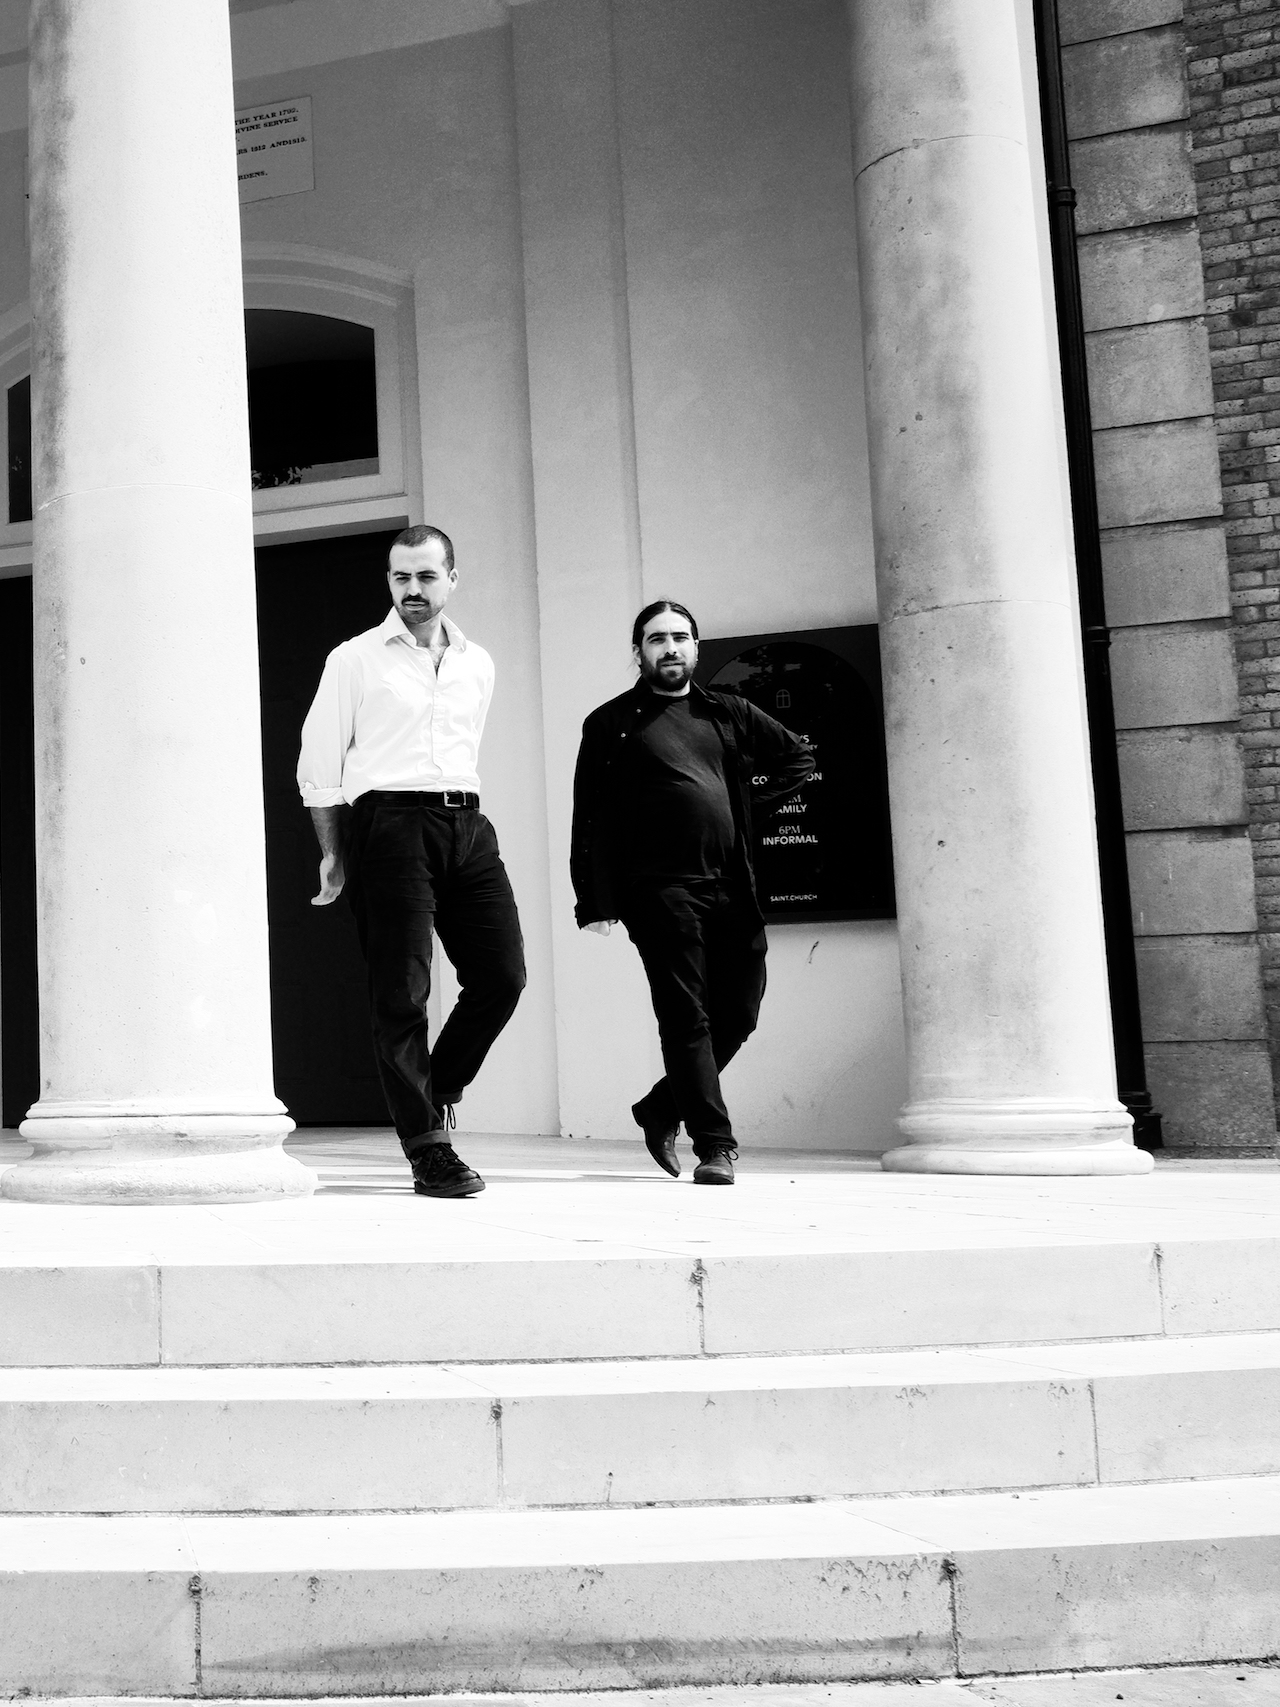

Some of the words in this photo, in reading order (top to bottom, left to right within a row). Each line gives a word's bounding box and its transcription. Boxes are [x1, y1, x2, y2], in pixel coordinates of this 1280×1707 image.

[234, 117, 251, 126] THE
[253, 112, 277, 121] YEAR
[263, 116, 298, 128] SERVICE
[774, 804, 807, 815] AMILY
[778, 825, 801, 835] 6PM
[762, 834, 819, 846] INFORMAL
[770, 894, 818, 902] SAINT.CHURCH
